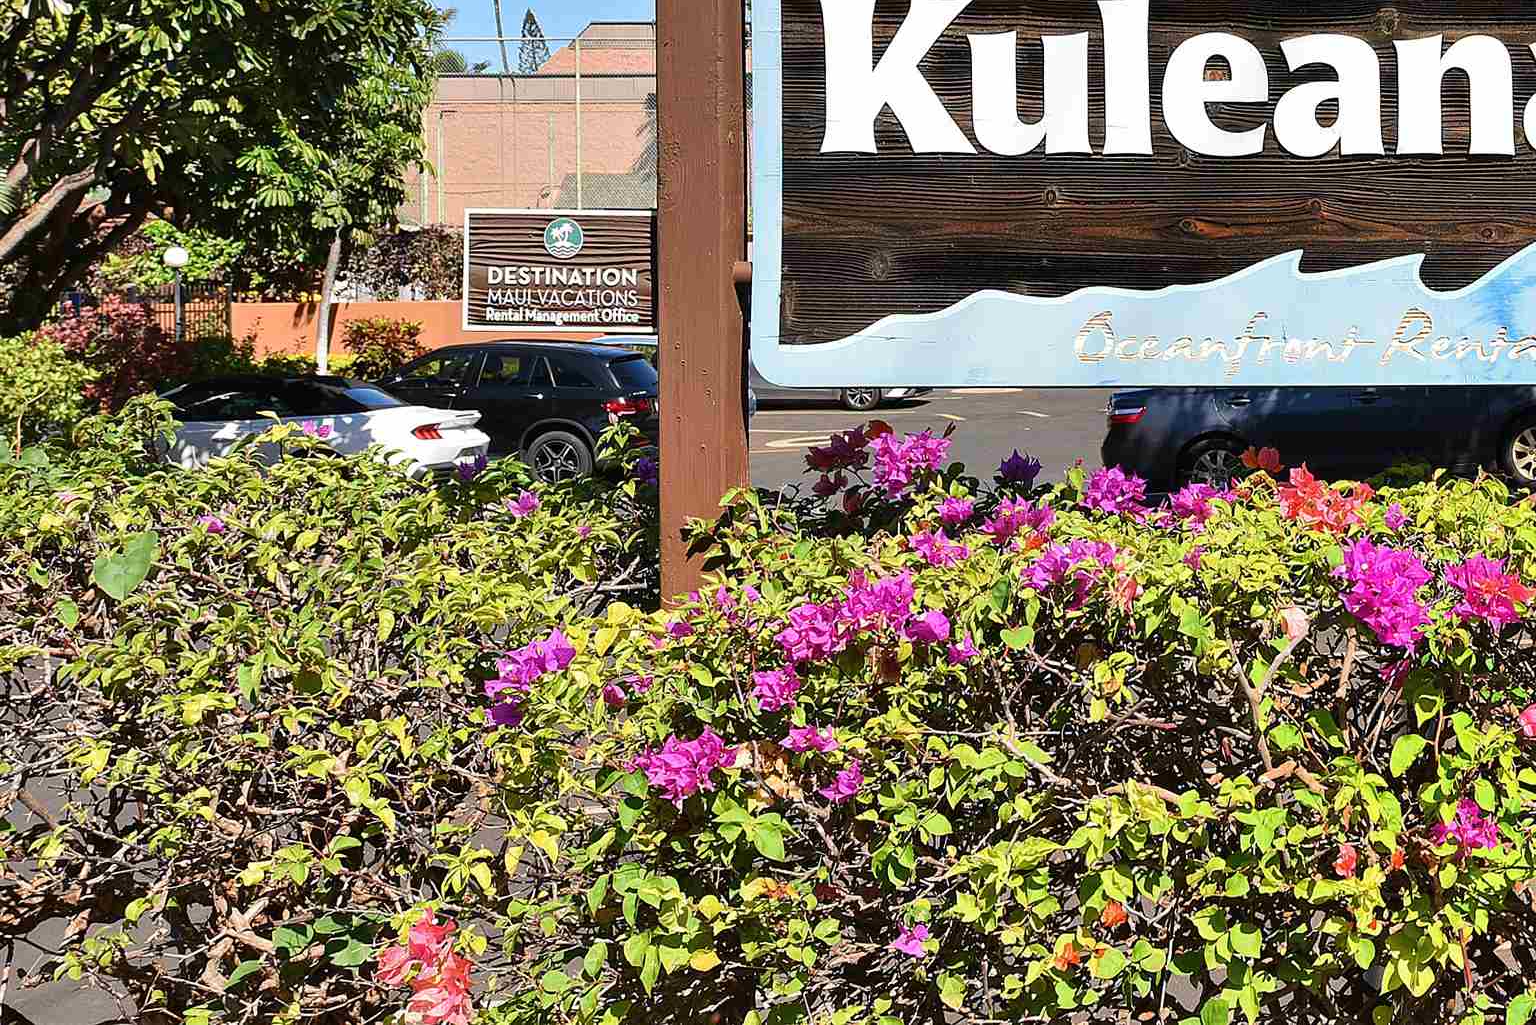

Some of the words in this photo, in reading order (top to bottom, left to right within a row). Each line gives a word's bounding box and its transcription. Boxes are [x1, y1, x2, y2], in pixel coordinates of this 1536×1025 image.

[487, 266, 638, 286] DESTINATION
[487, 288, 532, 306] MAUI
[537, 288, 639, 307] VACATIONS
[485, 307, 523, 322] Rental
[525, 308, 600, 325] Management
[601, 307, 640, 323] Office
[1073, 309, 1376, 378] Oceanfront
